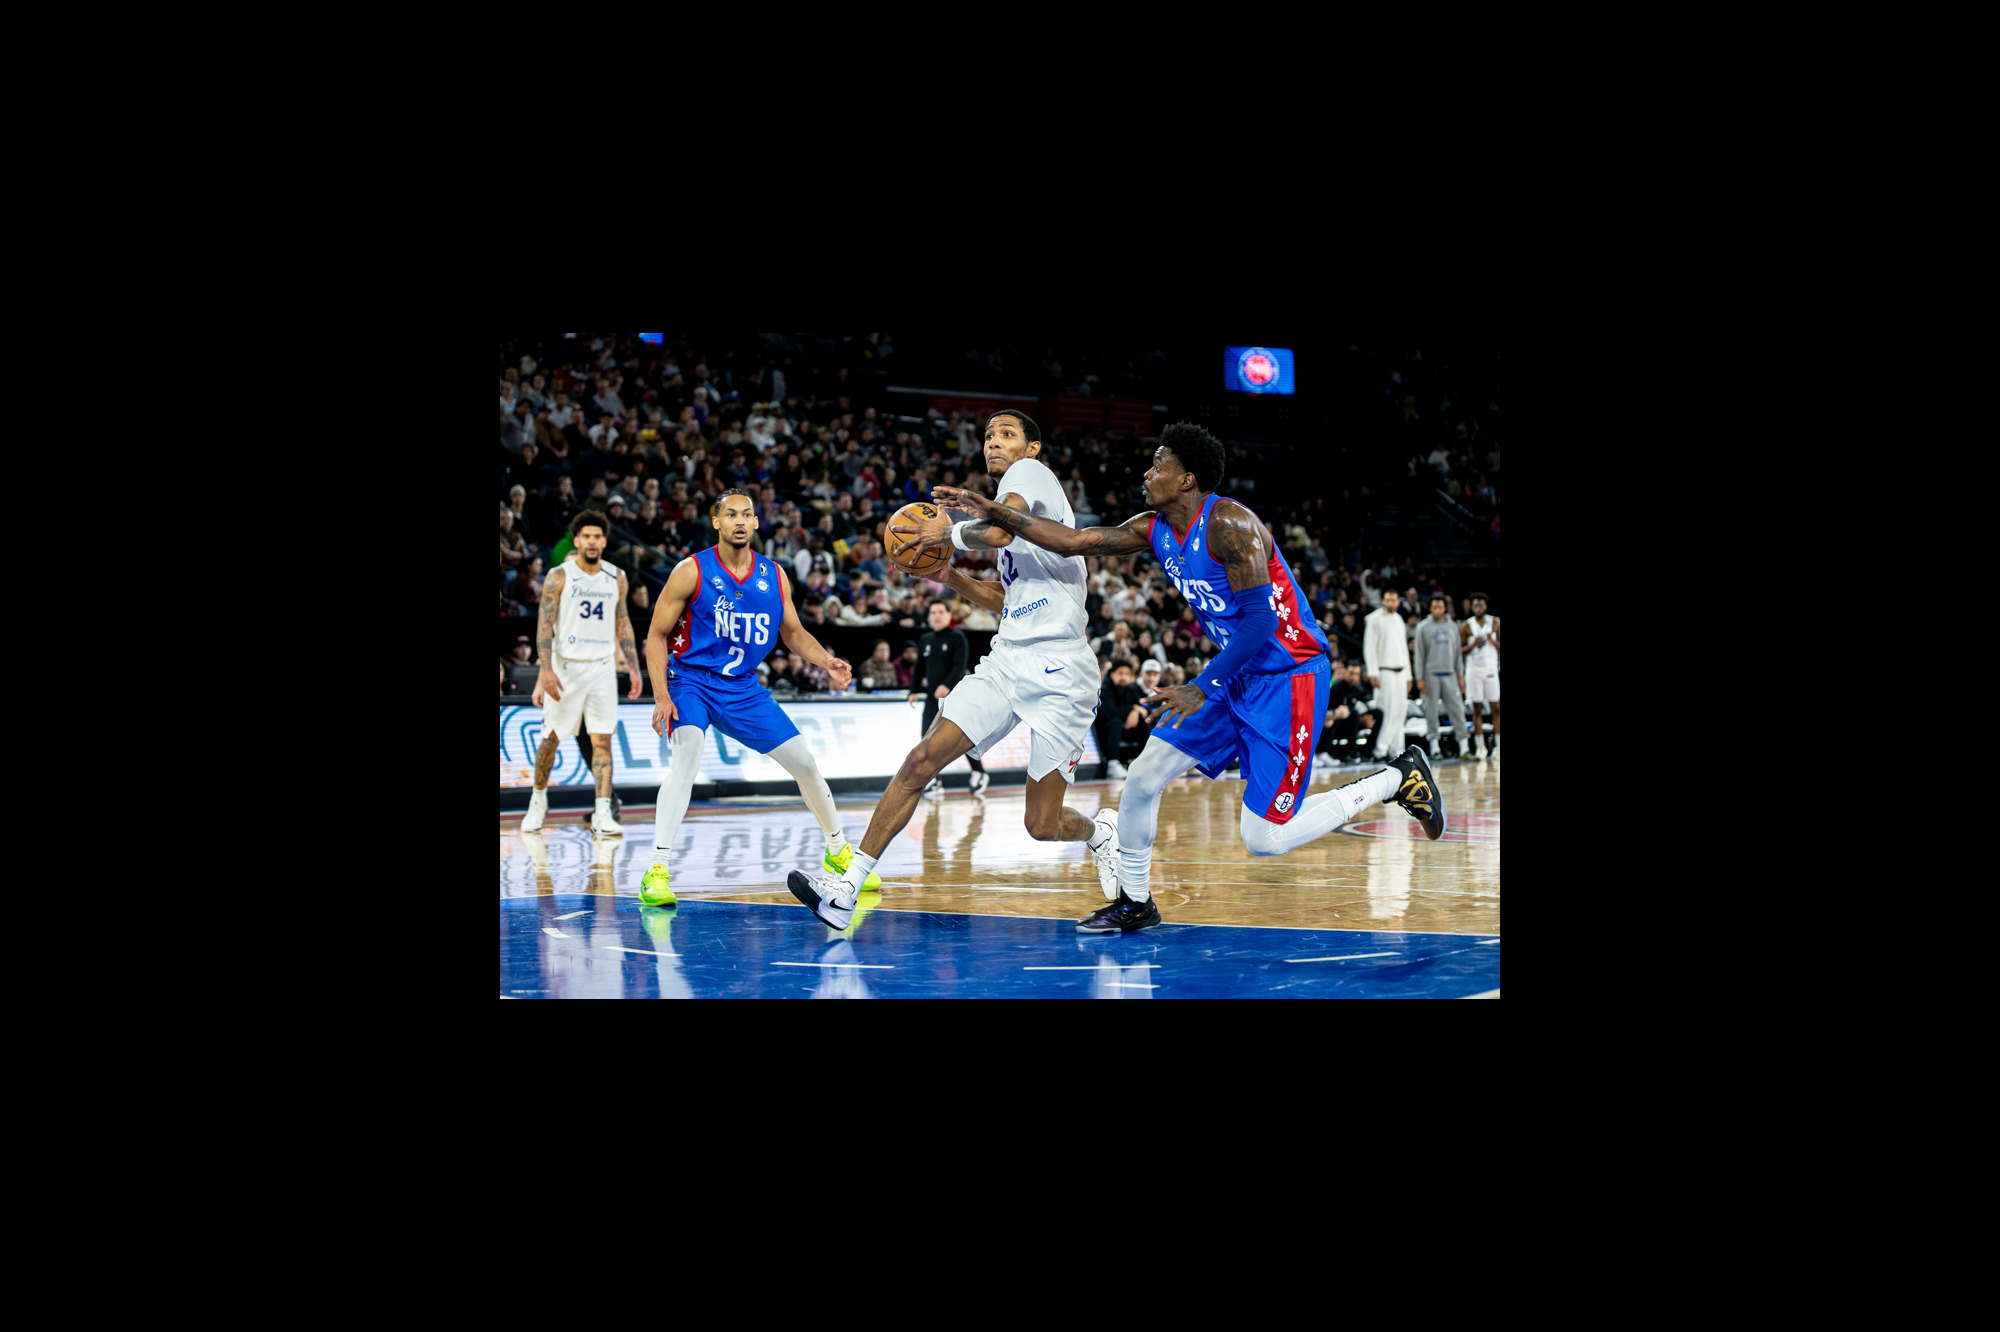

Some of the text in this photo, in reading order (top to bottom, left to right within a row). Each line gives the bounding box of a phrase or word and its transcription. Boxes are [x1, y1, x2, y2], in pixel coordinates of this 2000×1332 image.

[914, 503, 938, 519] ilso
[580, 600, 603, 620] 34
[713, 595, 735, 612] Les
[1010, 597, 1049, 619] ypto.com
[714, 610, 770, 645] NETS
[722, 645, 745, 677] 2
